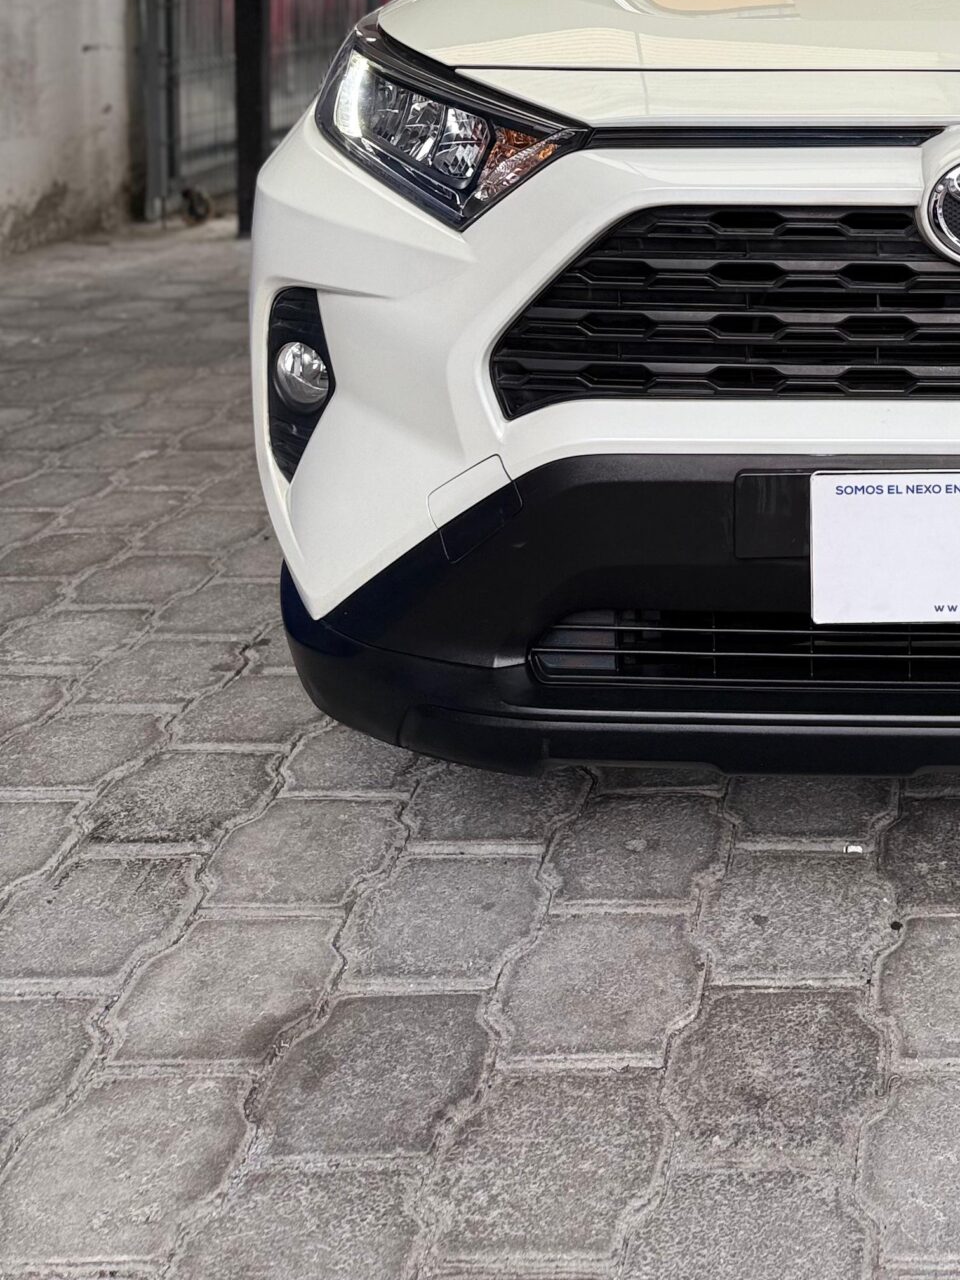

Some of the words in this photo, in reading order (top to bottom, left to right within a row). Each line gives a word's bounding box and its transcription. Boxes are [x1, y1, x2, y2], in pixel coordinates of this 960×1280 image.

[835, 485, 884, 495] SOMOS
[887, 485, 903, 495] EL
[905, 484, 942, 494] NEXO
